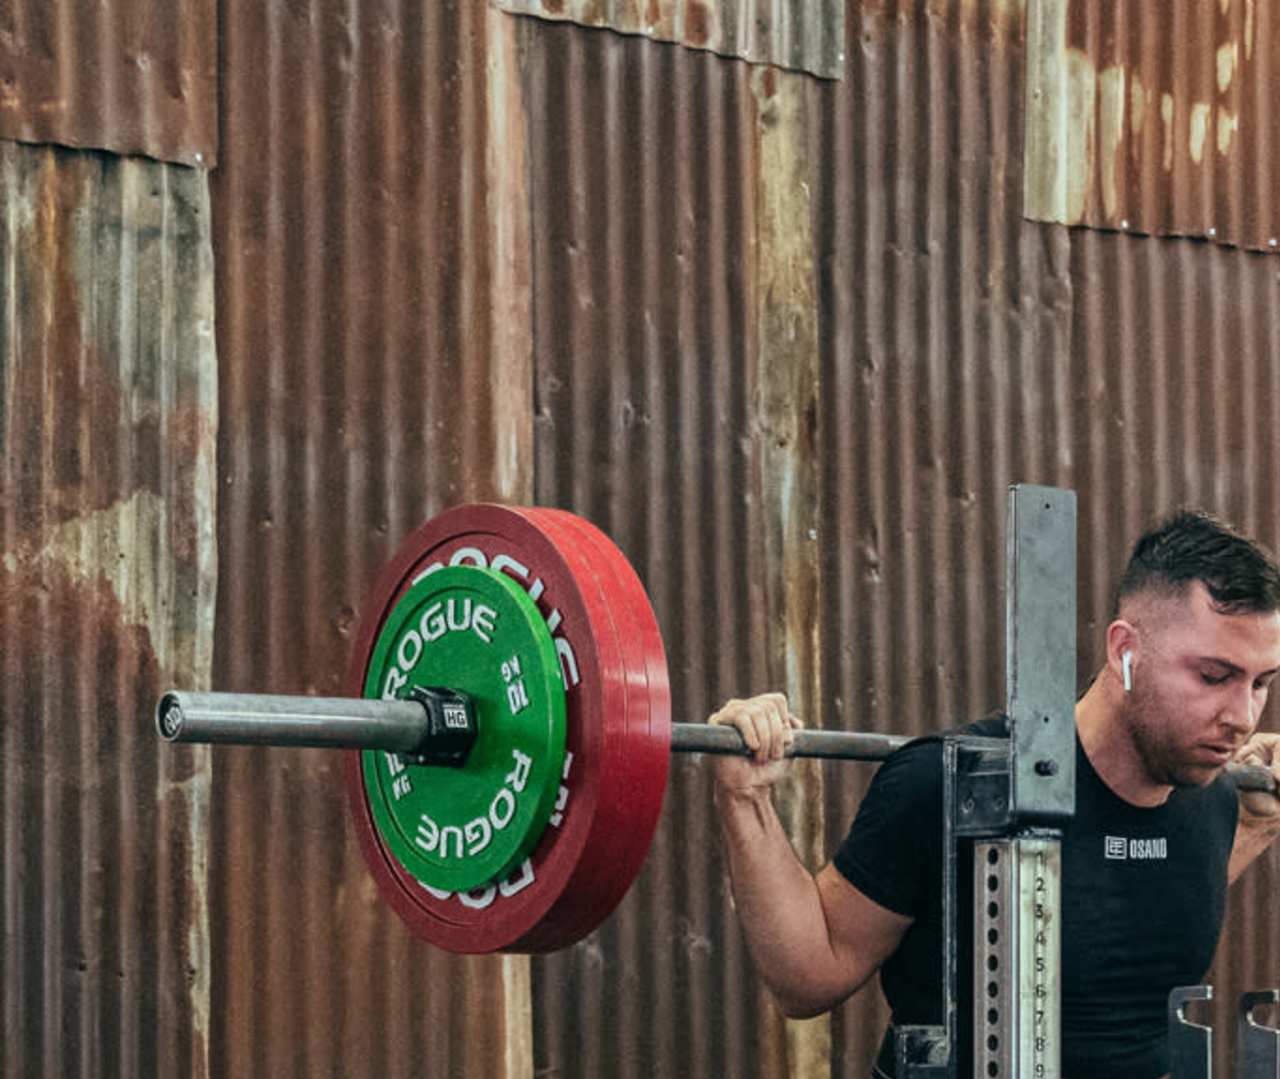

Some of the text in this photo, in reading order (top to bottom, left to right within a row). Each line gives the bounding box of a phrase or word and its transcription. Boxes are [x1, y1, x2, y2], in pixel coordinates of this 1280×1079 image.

[382, 598, 497, 701] ROGUE
[415, 749, 532, 859] ROGUE
[1036, 851, 1044, 866] 1
[1036, 878, 1046, 892] 2
[1035, 905, 1044, 918] 3
[1035, 932, 1047, 946] 4
[1036, 958, 1045, 973] 5
[1036, 984, 1047, 998] 6
[1036, 1011, 1045, 1026] 7
[1036, 1038, 1045, 1052] 8
[1036, 1064, 1045, 1079] 9
